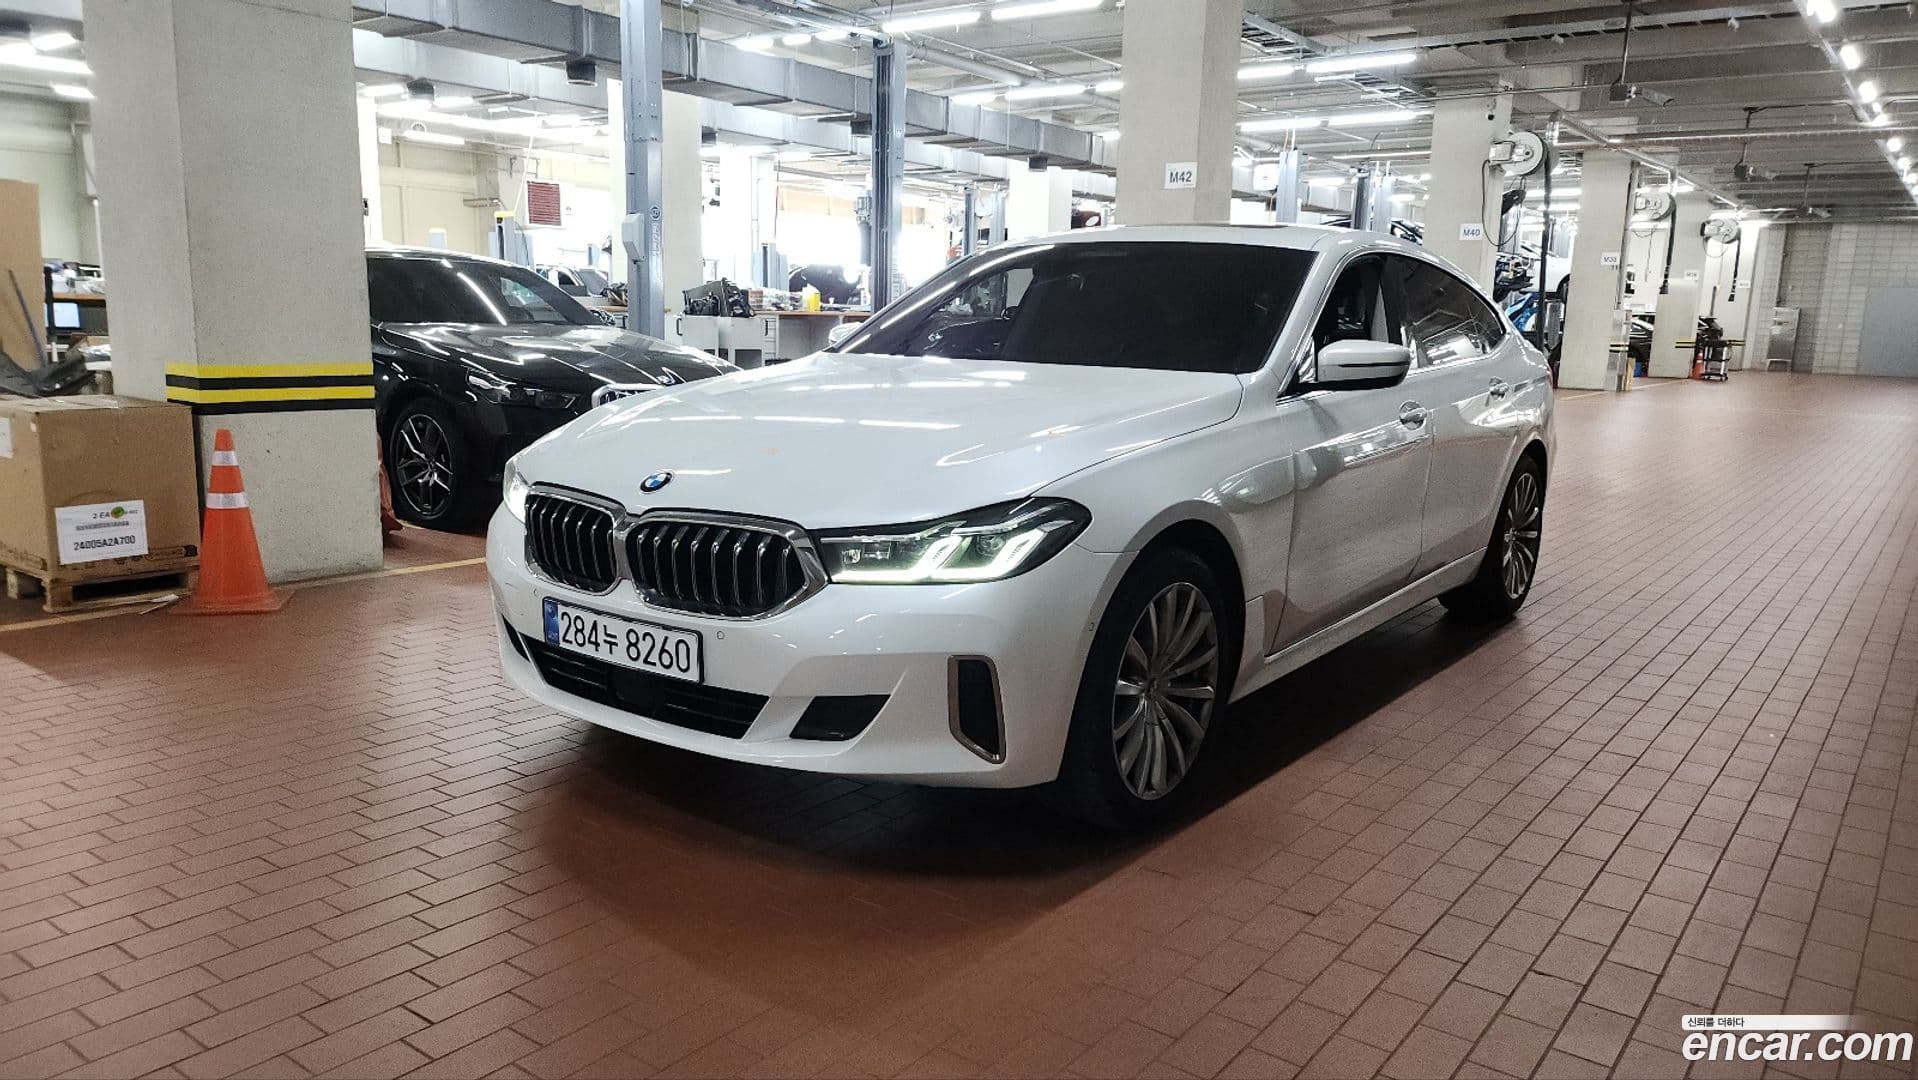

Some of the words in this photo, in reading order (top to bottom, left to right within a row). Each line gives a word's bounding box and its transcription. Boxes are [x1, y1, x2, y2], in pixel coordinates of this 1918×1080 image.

[1169, 170, 1193, 183] M42
[1462, 228, 1481, 237] M40
[560, 611, 619, 655] 284누
[625, 627, 691, 673] 8260
